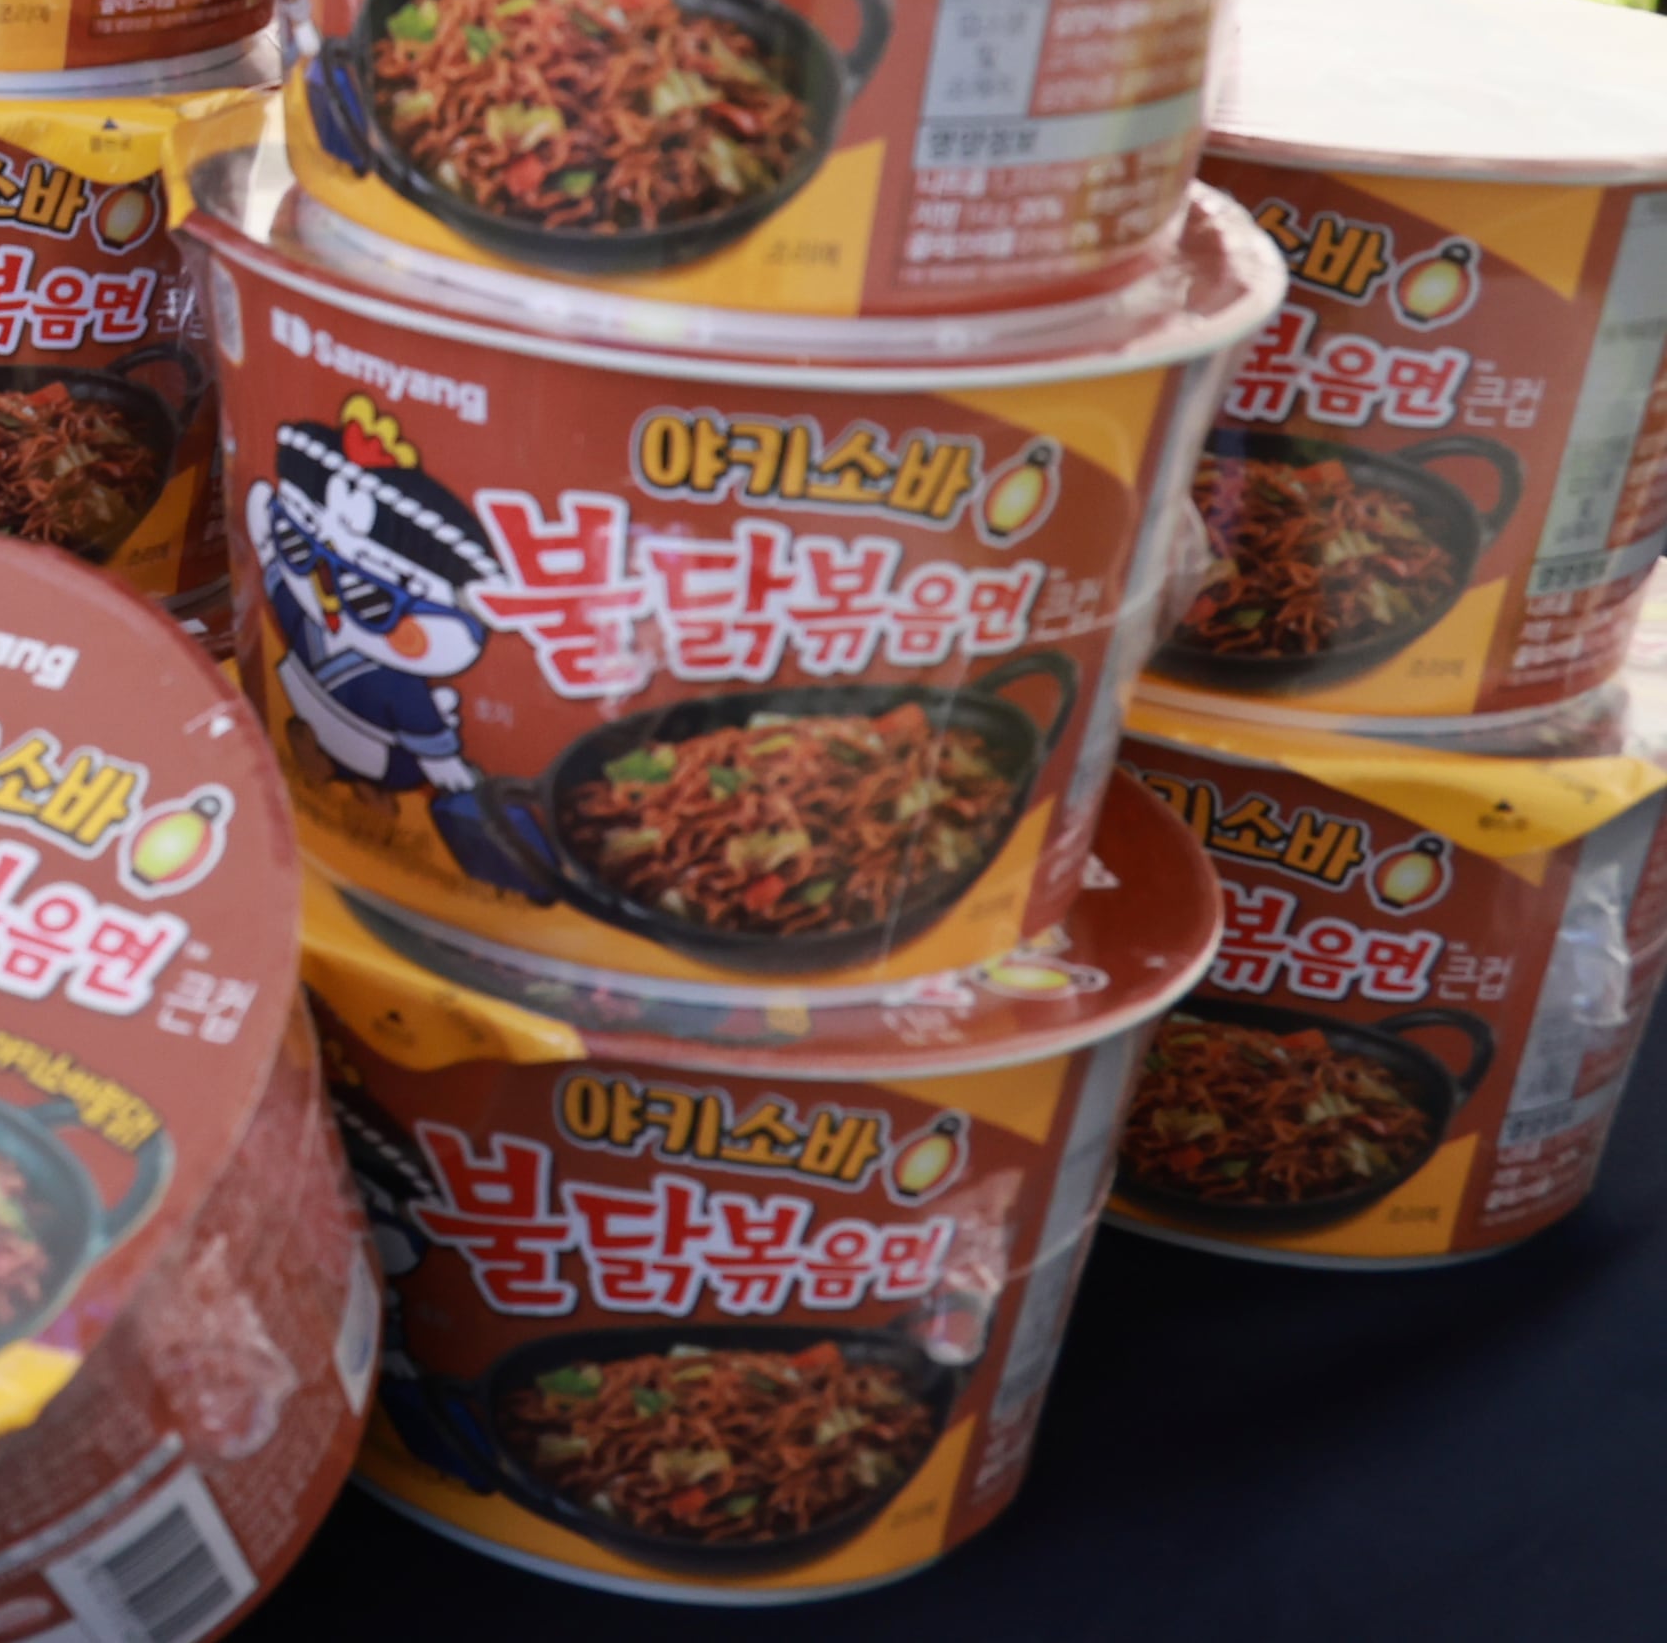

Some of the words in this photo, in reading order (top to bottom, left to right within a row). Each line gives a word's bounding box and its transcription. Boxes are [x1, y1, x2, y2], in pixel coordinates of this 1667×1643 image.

[313, 330, 489, 427] Samyang
[1462, 372, 1545, 432] 큰컵
[629, 406, 979, 524] 야키소바
[465, 487, 1048, 701] 불닭볶음면
[157, 972, 259, 1044] 큰컵
[555, 1069, 889, 1184] 야키소바
[410, 1120, 957, 1318] 불닭볶음면
